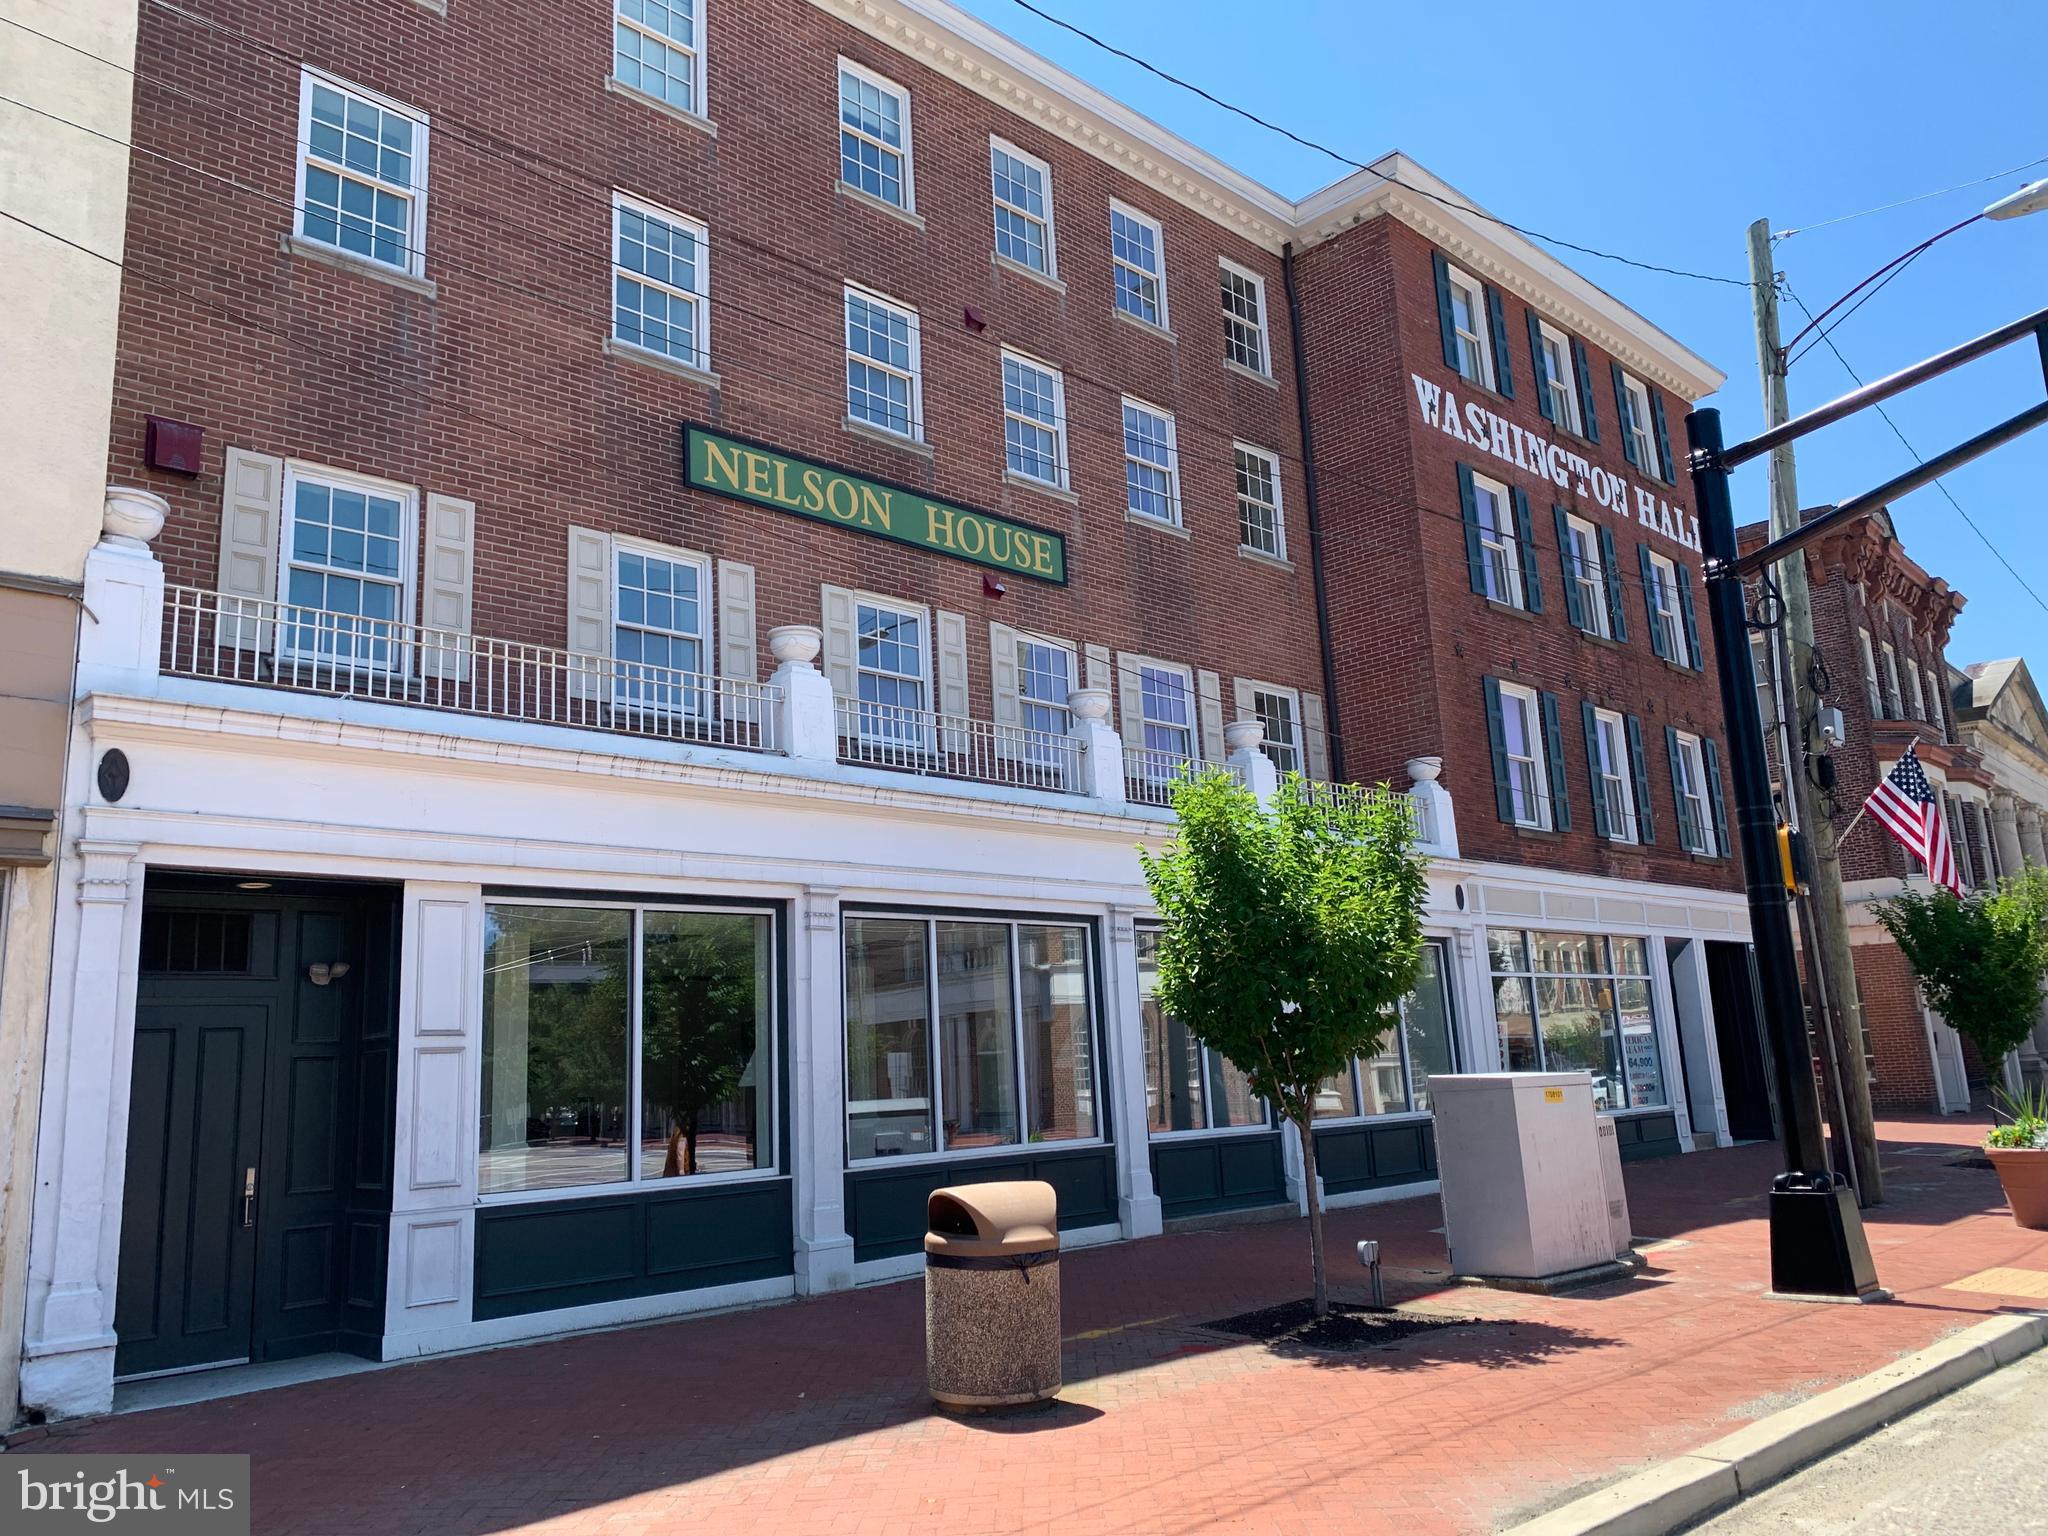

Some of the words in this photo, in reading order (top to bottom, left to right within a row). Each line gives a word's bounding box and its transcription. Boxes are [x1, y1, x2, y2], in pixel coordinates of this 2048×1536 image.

[703, 439, 893, 531] NELSON
[924, 504, 1054, 574] HOUSE
[1411, 373, 1629, 517] WASHINGTON
